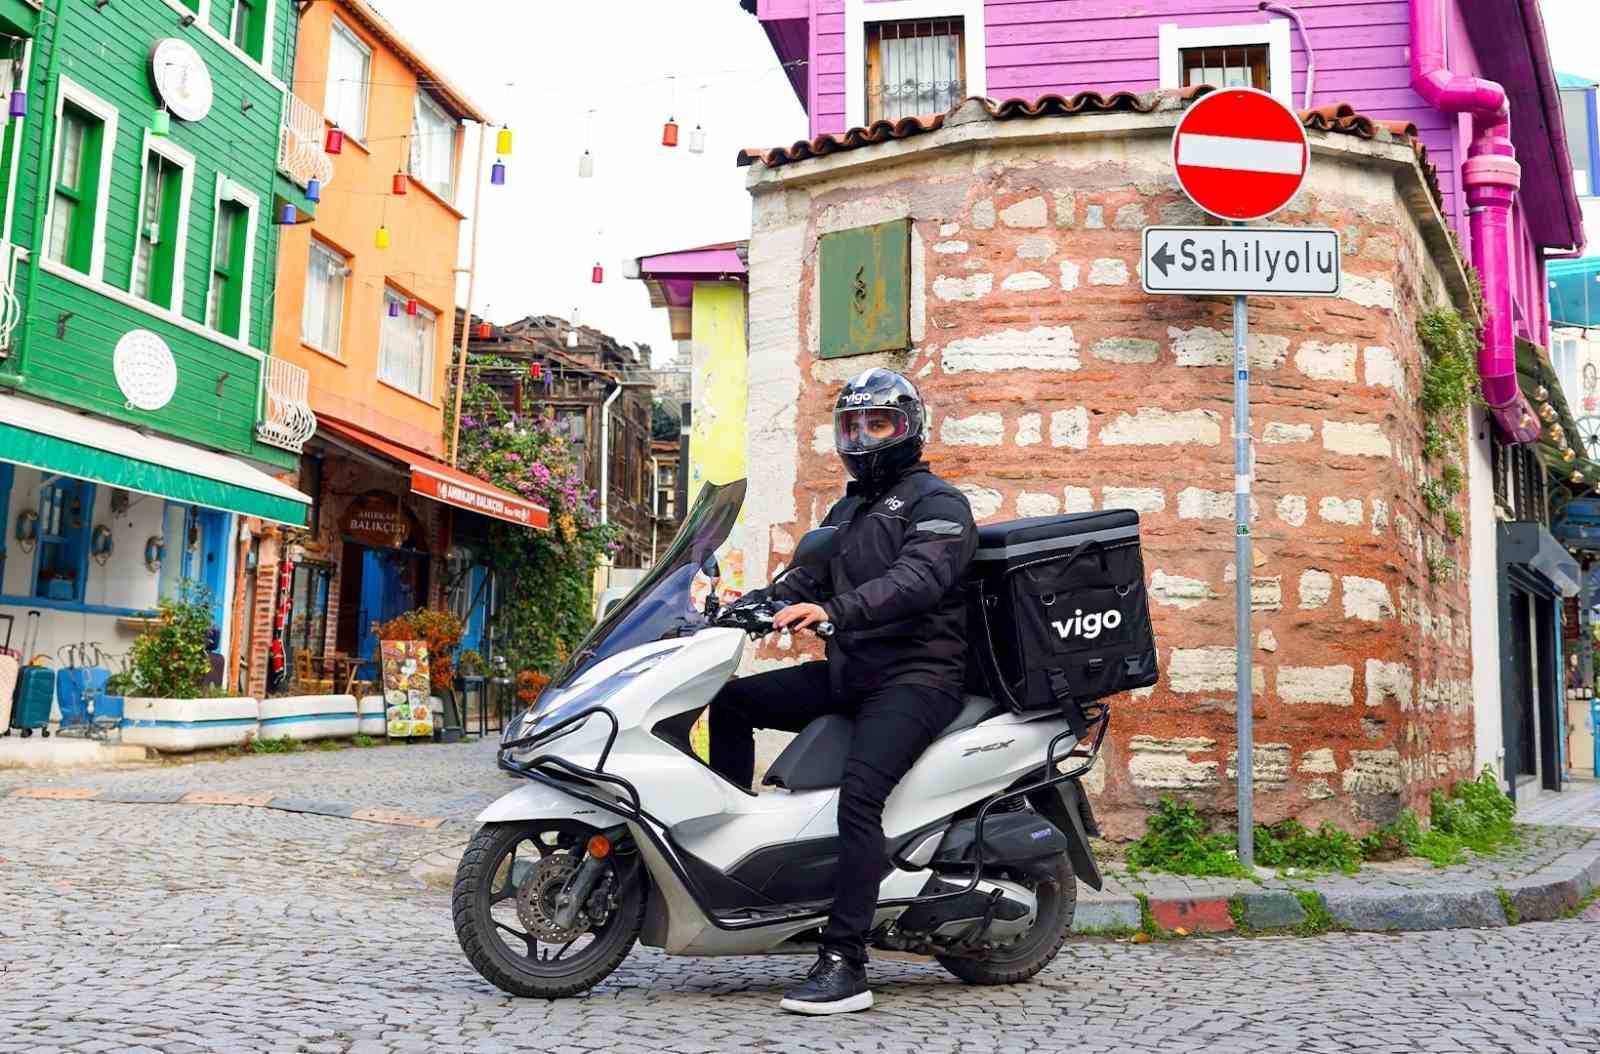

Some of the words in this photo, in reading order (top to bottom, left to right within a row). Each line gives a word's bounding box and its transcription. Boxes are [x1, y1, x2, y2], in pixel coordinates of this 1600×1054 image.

[1180, 238, 1332, 282] Sahilyolu
[842, 391, 872, 404] vigo
[1051, 608, 1122, 639] vigo
